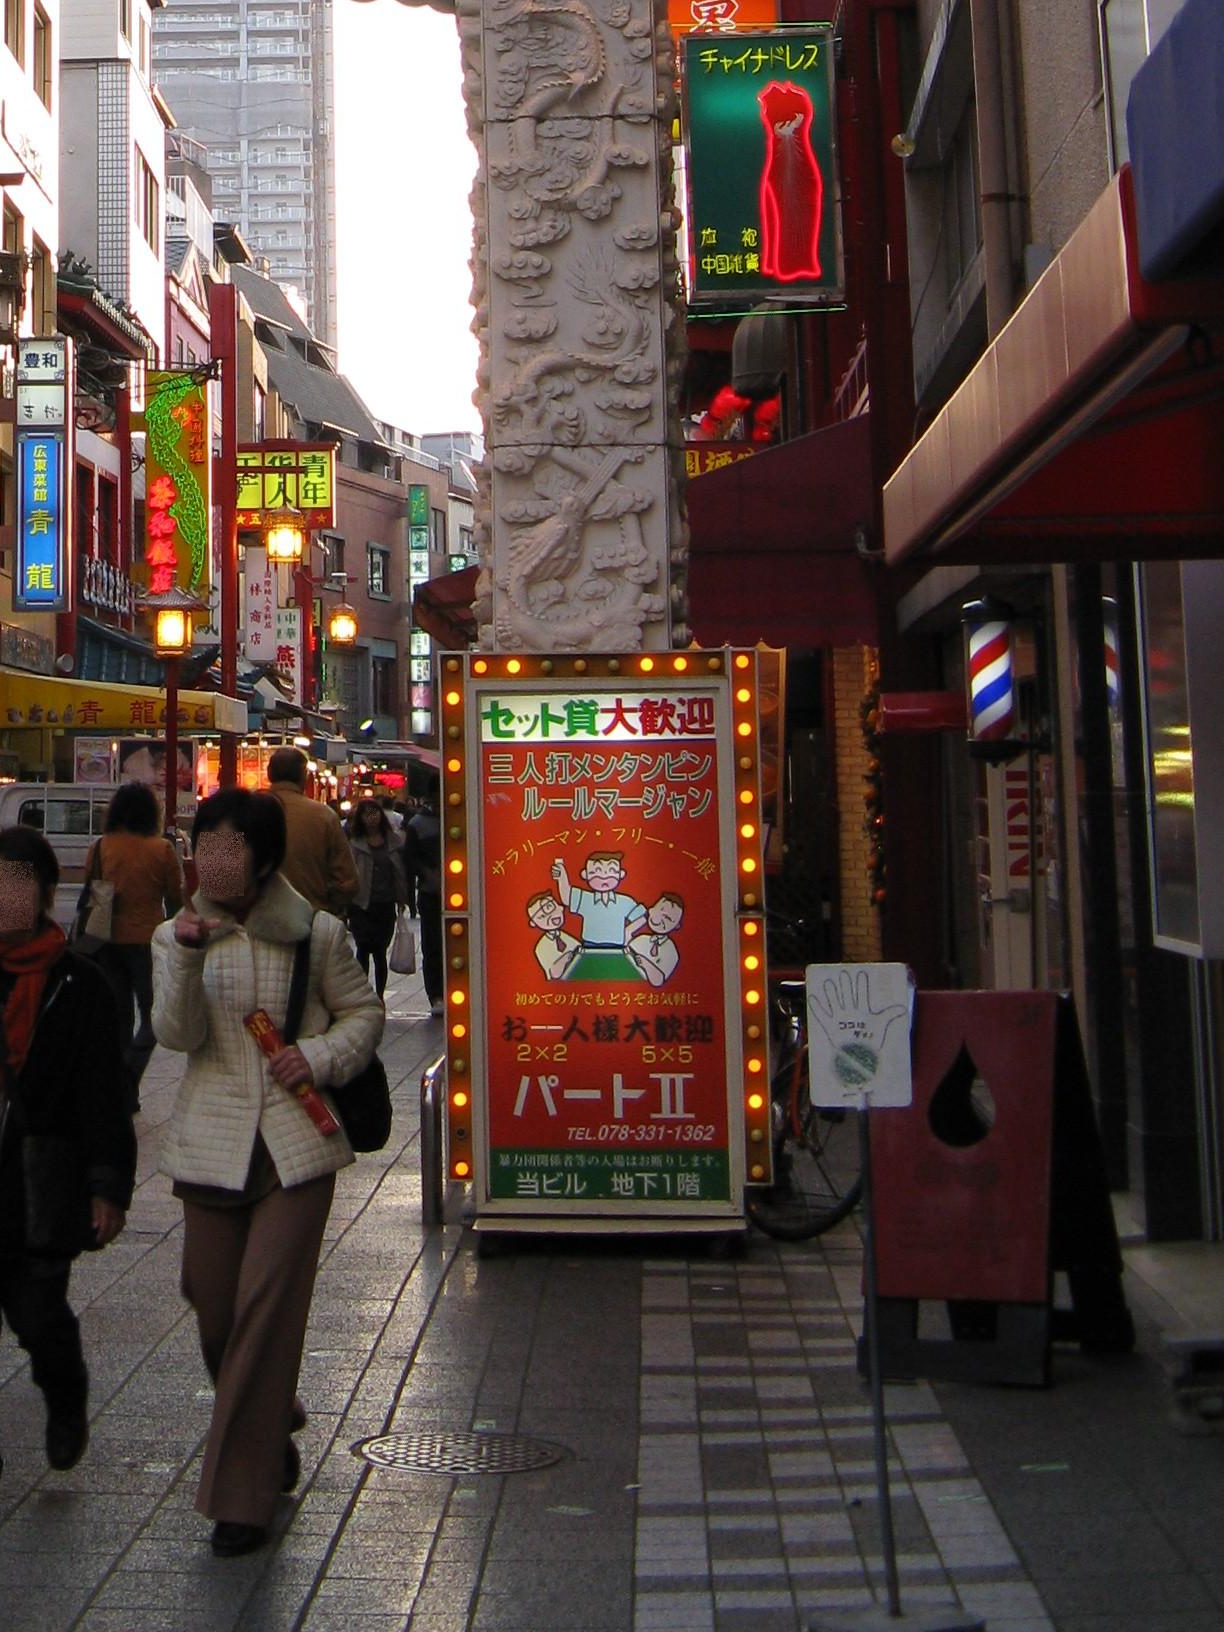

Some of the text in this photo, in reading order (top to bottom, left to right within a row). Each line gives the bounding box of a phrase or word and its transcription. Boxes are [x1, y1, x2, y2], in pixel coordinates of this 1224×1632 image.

[698, 44, 820, 75] チャイナドレス
[24, 352, 58, 369] 豊和
[77, 699, 157, 725] 青龍
[481, 697, 716, 738] セット貸大歓迎
[488, 750, 713, 785] 三人打メンタンピン
[521, 784, 713, 821] ルールマージャン
[516, 1171, 701, 1197] 当ビル 地下1階
